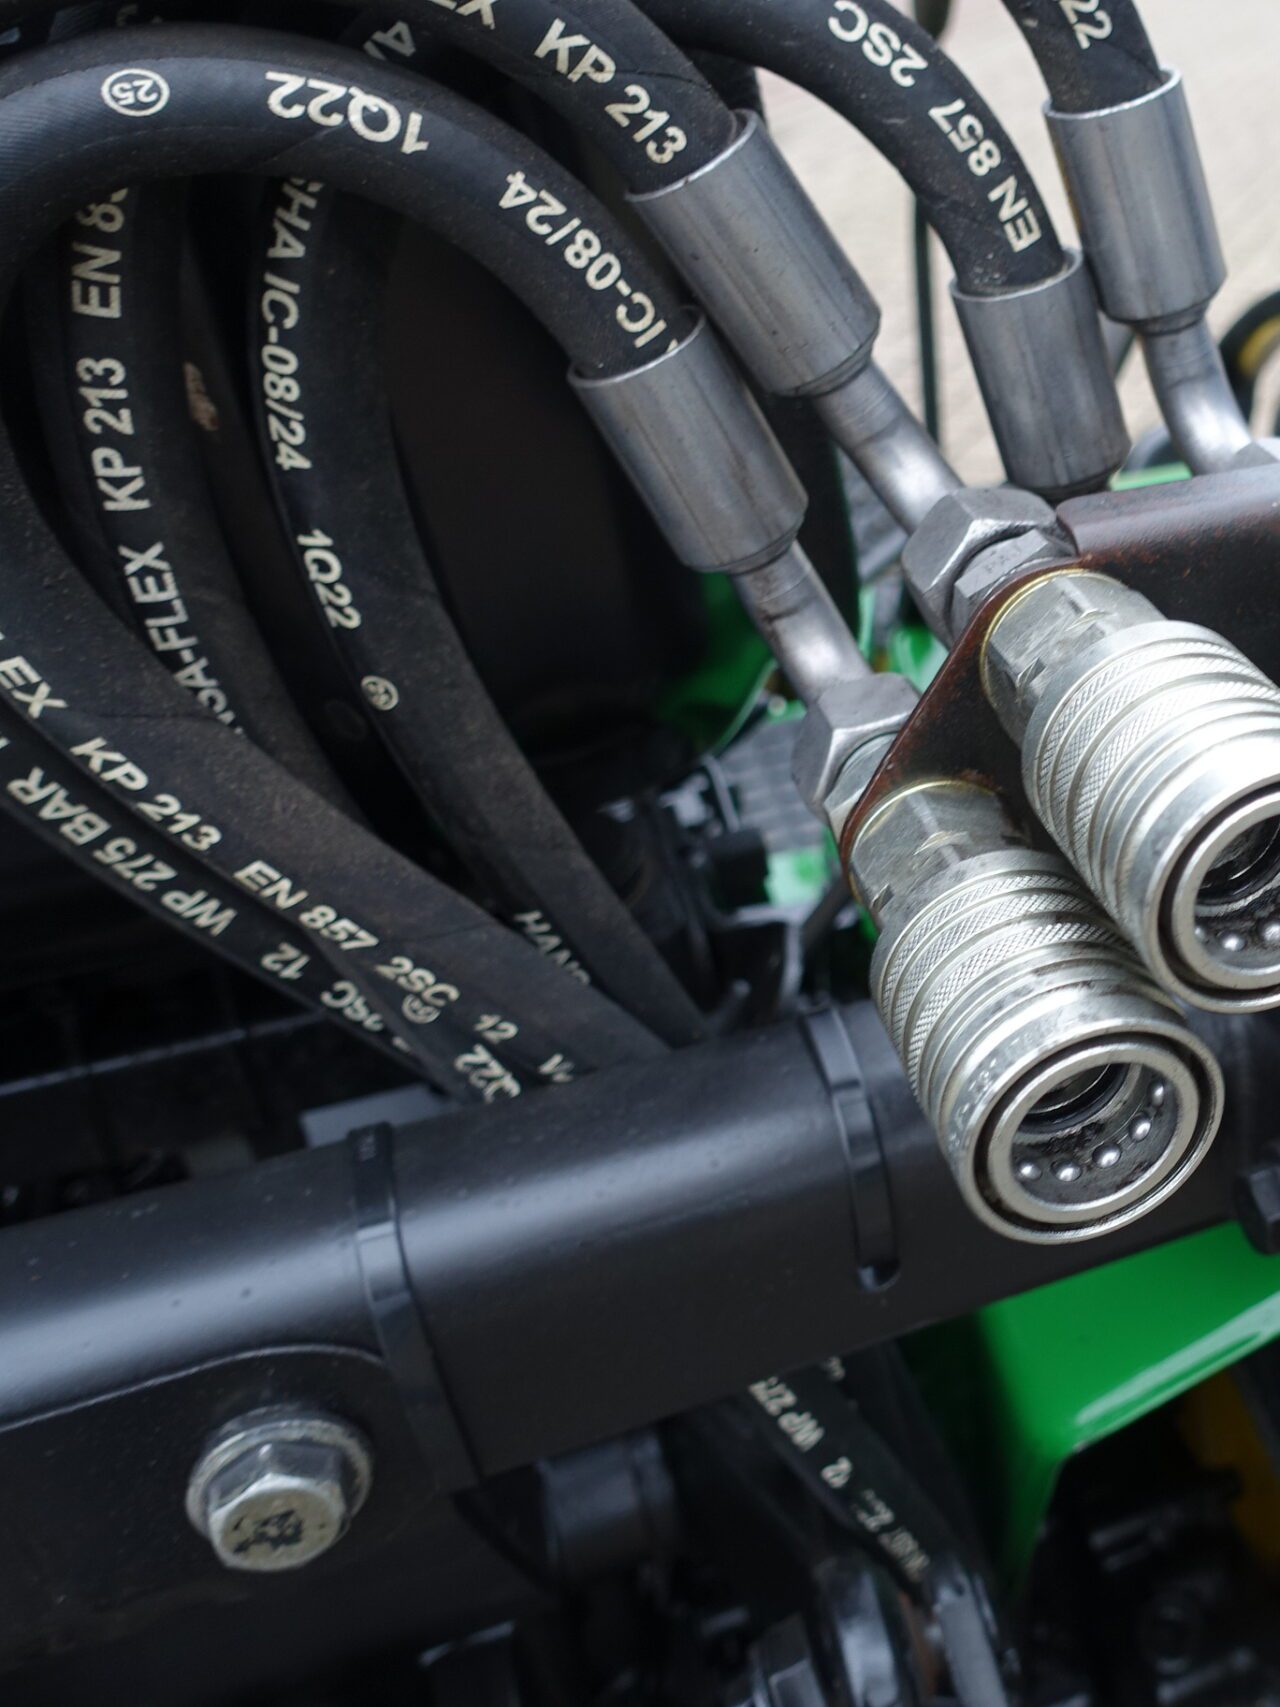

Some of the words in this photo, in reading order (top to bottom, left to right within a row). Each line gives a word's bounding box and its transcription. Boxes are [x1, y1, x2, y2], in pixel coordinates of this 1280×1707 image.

[828, 0, 928, 87] 2SC
[265, 70, 429, 155] 1Q22
[534, 18, 617, 83] KP
[604, 84, 688, 164] 213
[928, 98, 1001, 176] 857
[987, 175, 1042, 252] EN
[71, 241, 122, 319] EN
[499, 171, 667, 348] IC-08/24
[76, 357, 135, 436] 213
[91, 447, 151, 512] KP
[261, 272, 312, 471] IC-08/24
[297, 529, 361, 629] 1Q22
[6, 766, 111, 846] BAR
[70, 737, 149, 791] KP
[137, 793, 222, 851] 213
[233, 860, 309, 910] EN
[299, 904, 379, 950] 857
[374, 956, 460, 1006] 2SC
[473, 1014, 518, 1044] 12
[93, 837, 178, 891] 275
[161, 890, 238, 937] WP
[261, 942, 310, 980] 12
